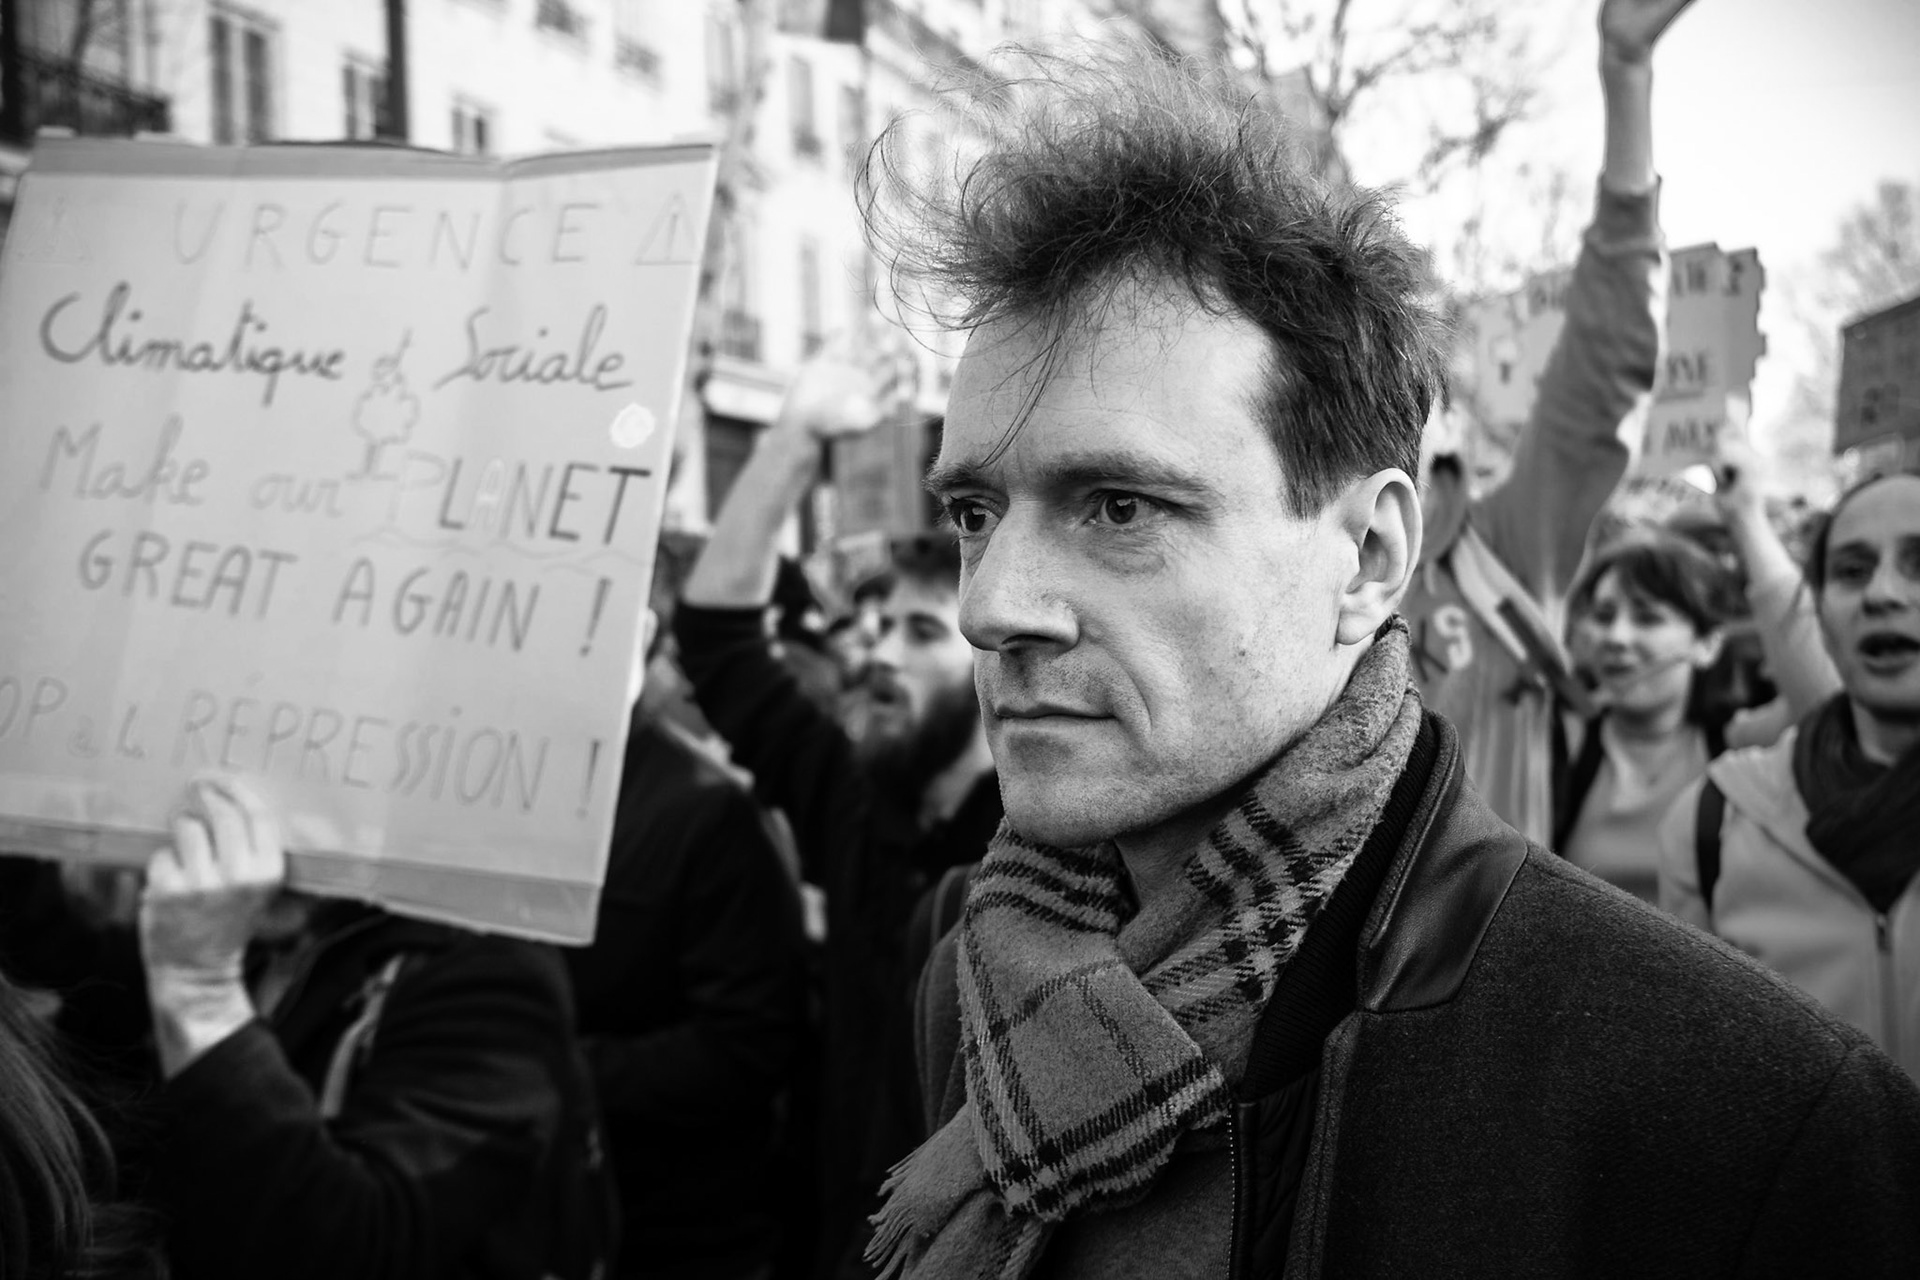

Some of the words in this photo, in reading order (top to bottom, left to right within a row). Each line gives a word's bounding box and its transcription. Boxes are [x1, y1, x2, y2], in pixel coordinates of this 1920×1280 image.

[174, 201, 598, 270] URGENCE
[39, 281, 346, 406] Climatique
[433, 304, 635, 391] Sociale
[40, 412, 210, 503] Make
[249, 472, 346, 518] our
[385, 448, 652, 545] PLANET
[78, 529, 299, 622] GREAT
[332, 557, 541, 653] AGAIN
